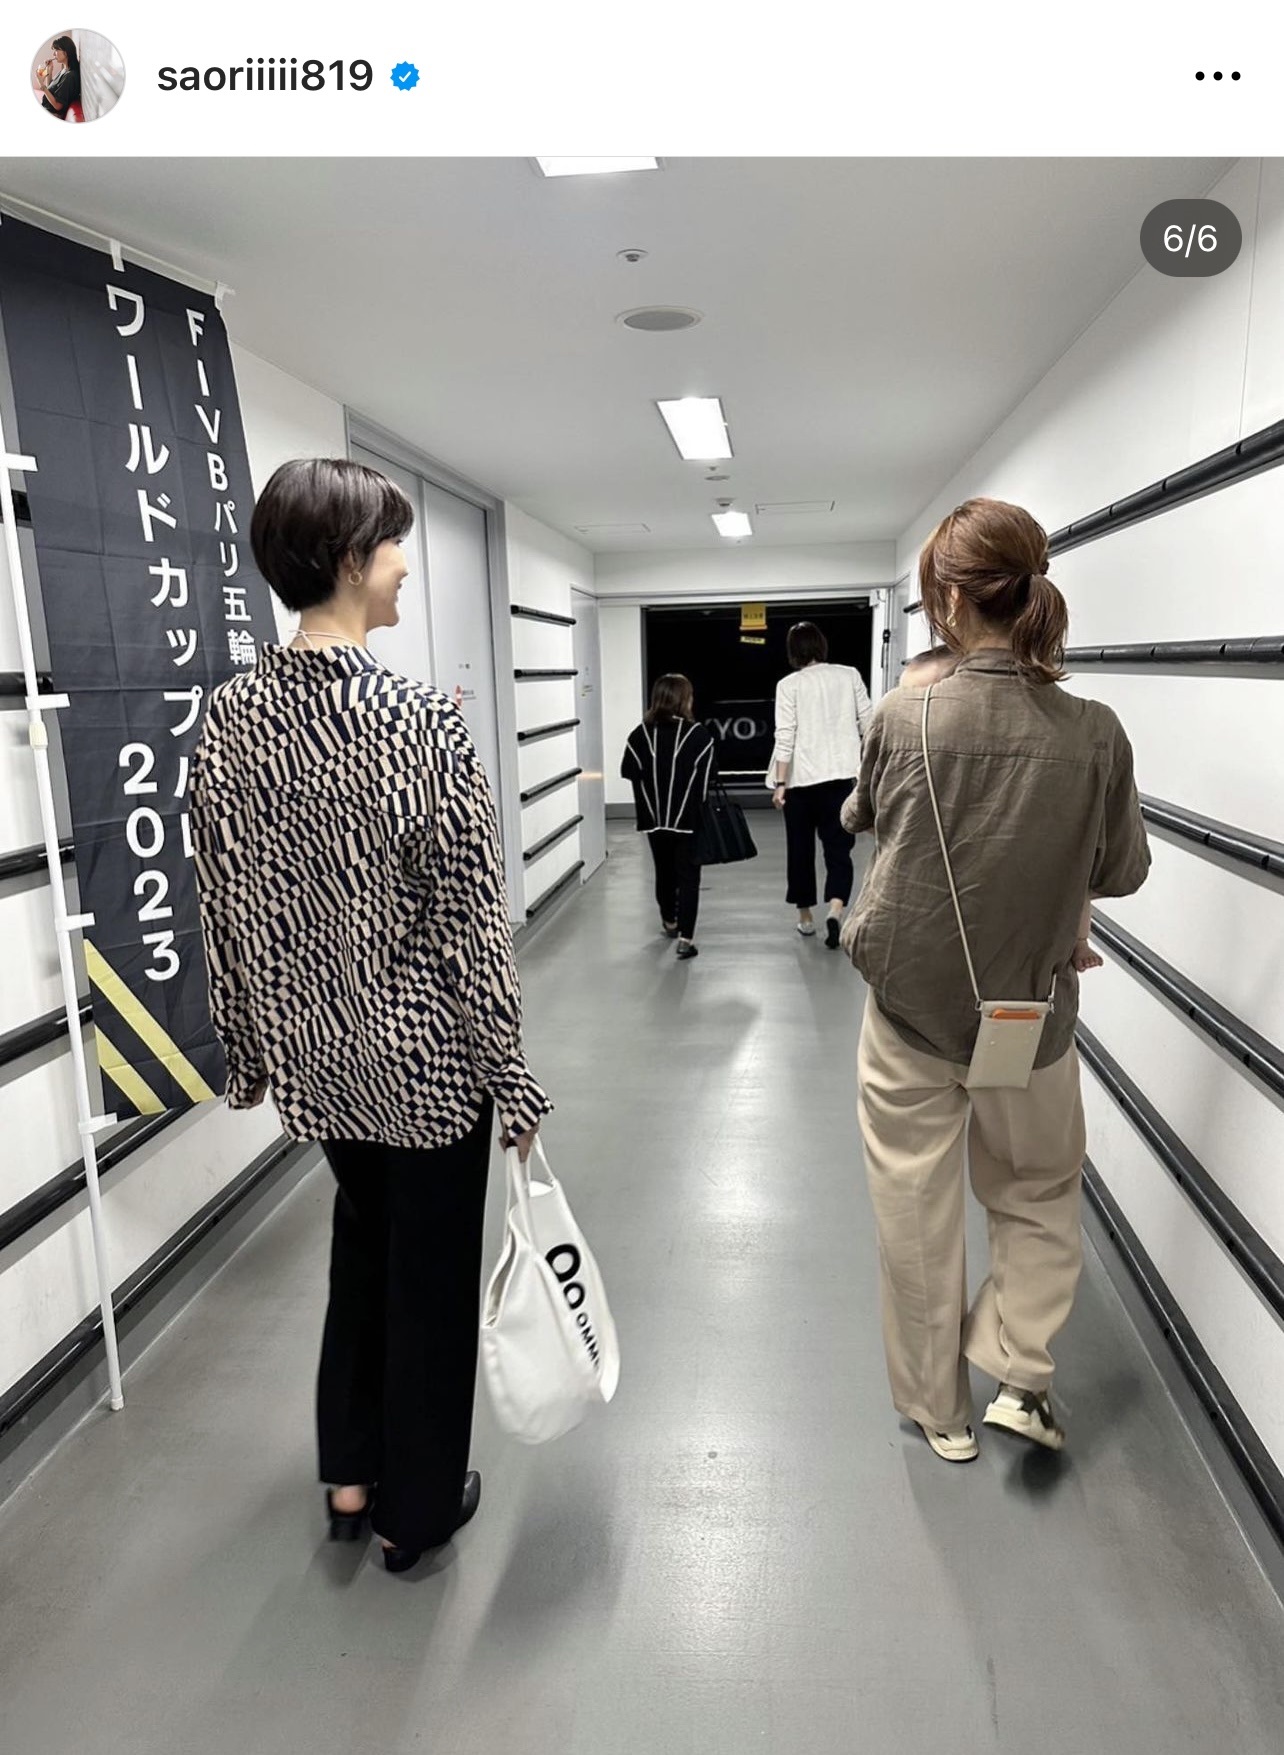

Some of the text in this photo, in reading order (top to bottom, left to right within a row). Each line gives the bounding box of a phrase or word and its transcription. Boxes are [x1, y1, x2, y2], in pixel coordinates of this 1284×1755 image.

[186, 308, 257, 678] FIVBパリ五輪
[705, 717, 757, 740] YO
[118, 742, 181, 981] 2023
